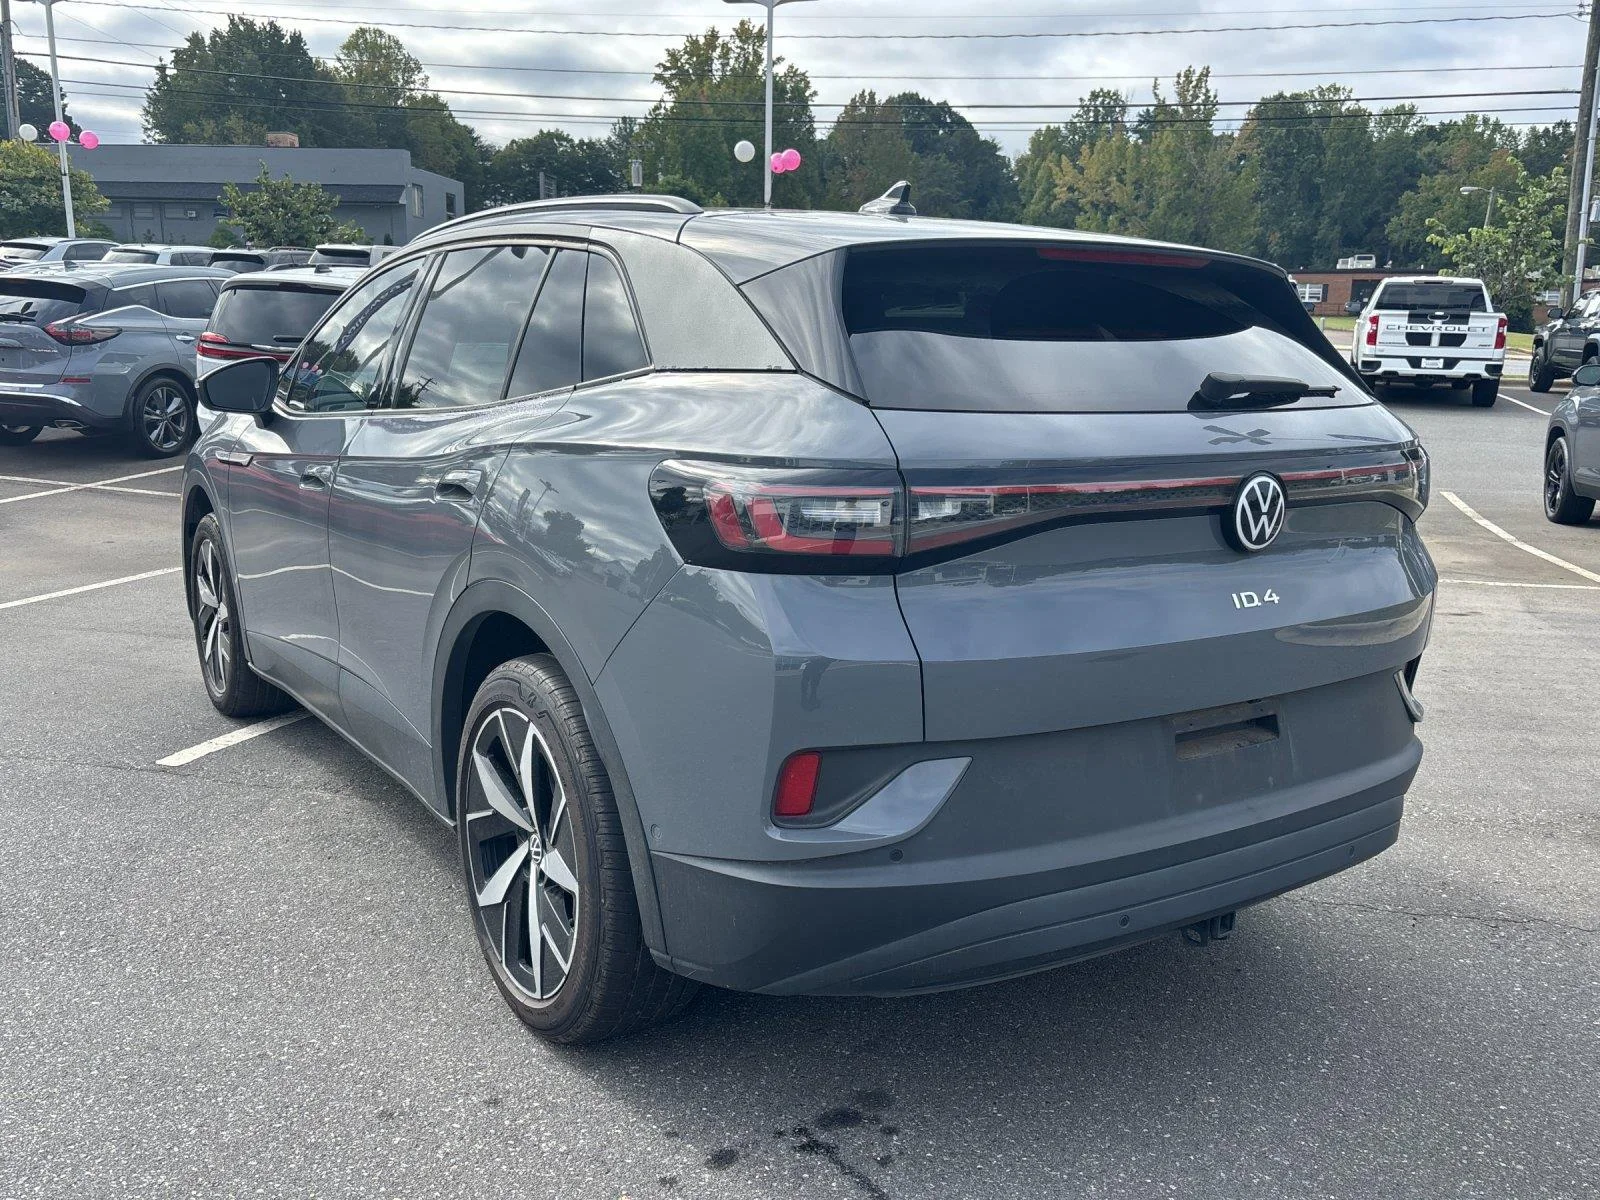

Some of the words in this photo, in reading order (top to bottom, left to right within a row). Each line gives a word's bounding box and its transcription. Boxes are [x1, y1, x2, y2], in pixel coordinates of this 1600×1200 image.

[1386, 324, 1489, 333] CHEVROLET
[1240, 479, 1282, 542] VW
[1231, 589, 1280, 609] ID.4
